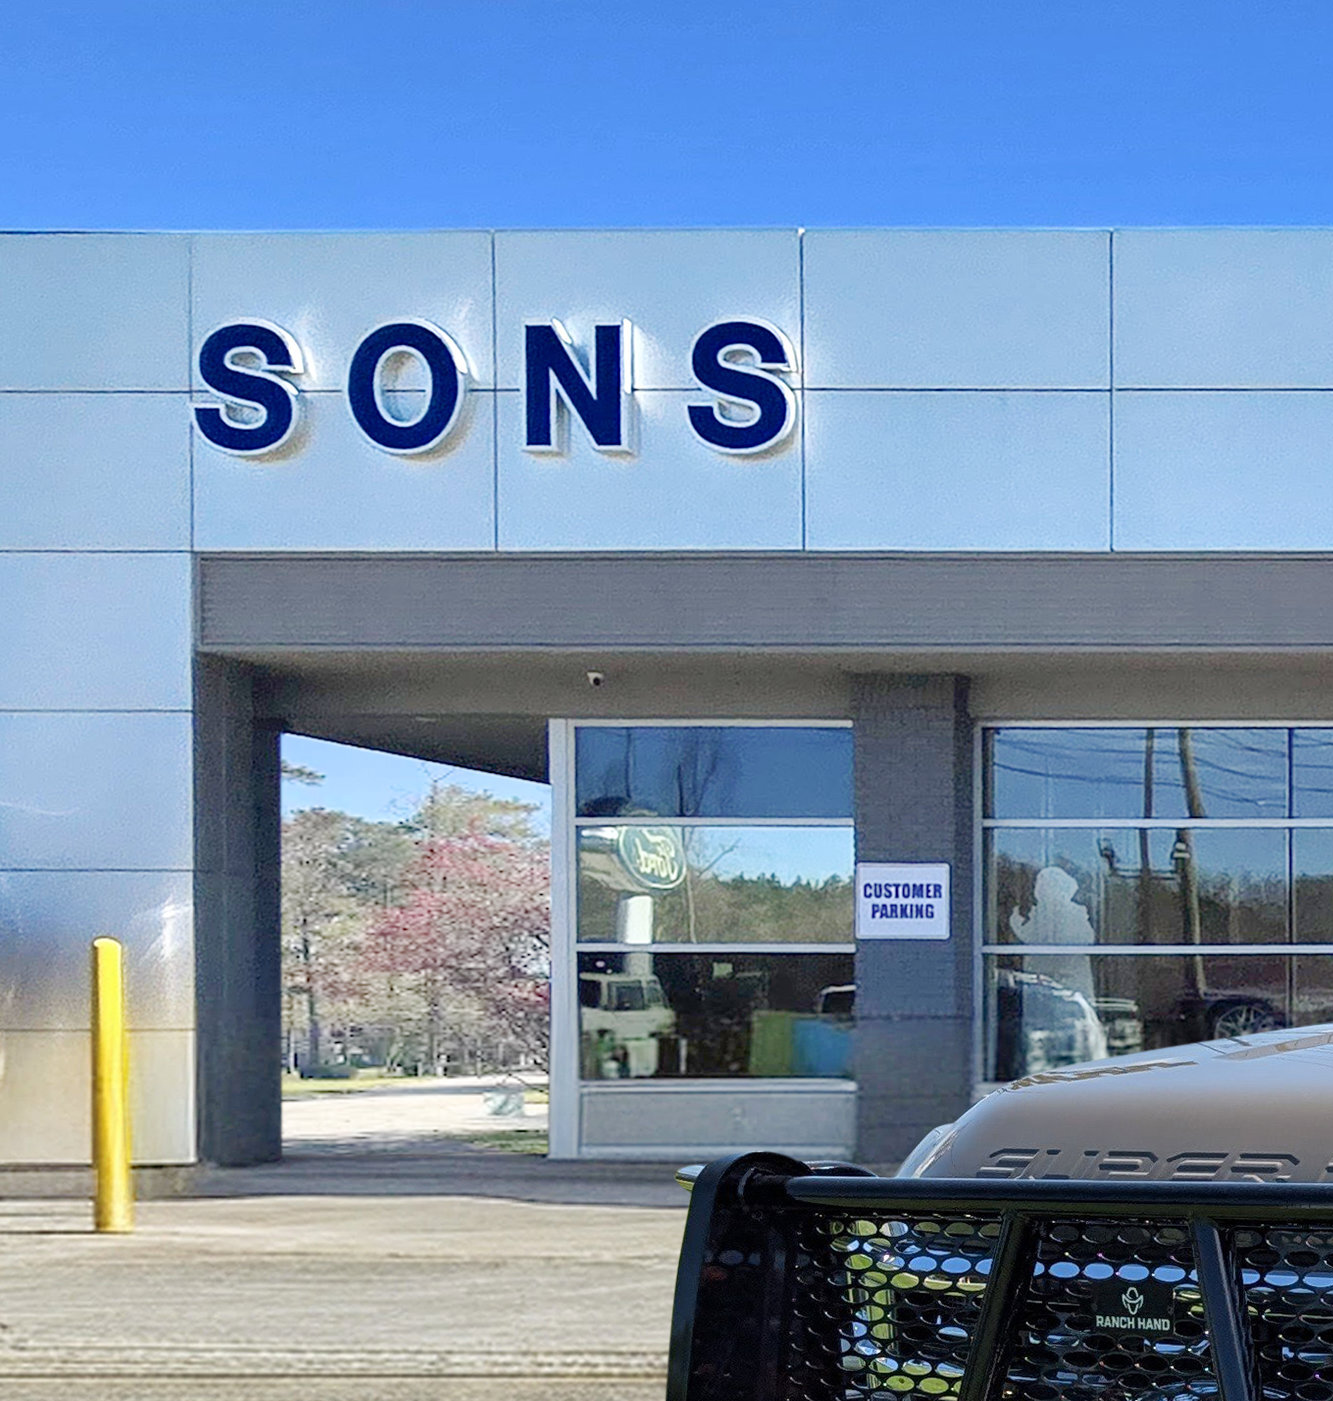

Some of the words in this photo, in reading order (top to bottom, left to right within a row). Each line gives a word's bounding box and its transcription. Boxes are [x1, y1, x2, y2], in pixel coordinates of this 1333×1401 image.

[194, 321, 796, 452] SONS
[863, 882, 943, 899] CUSTOMER
[871, 903, 935, 919] PARKING
[1095, 1315, 1135, 1329] RANCH
[1137, 1317, 1171, 1331] HAND
